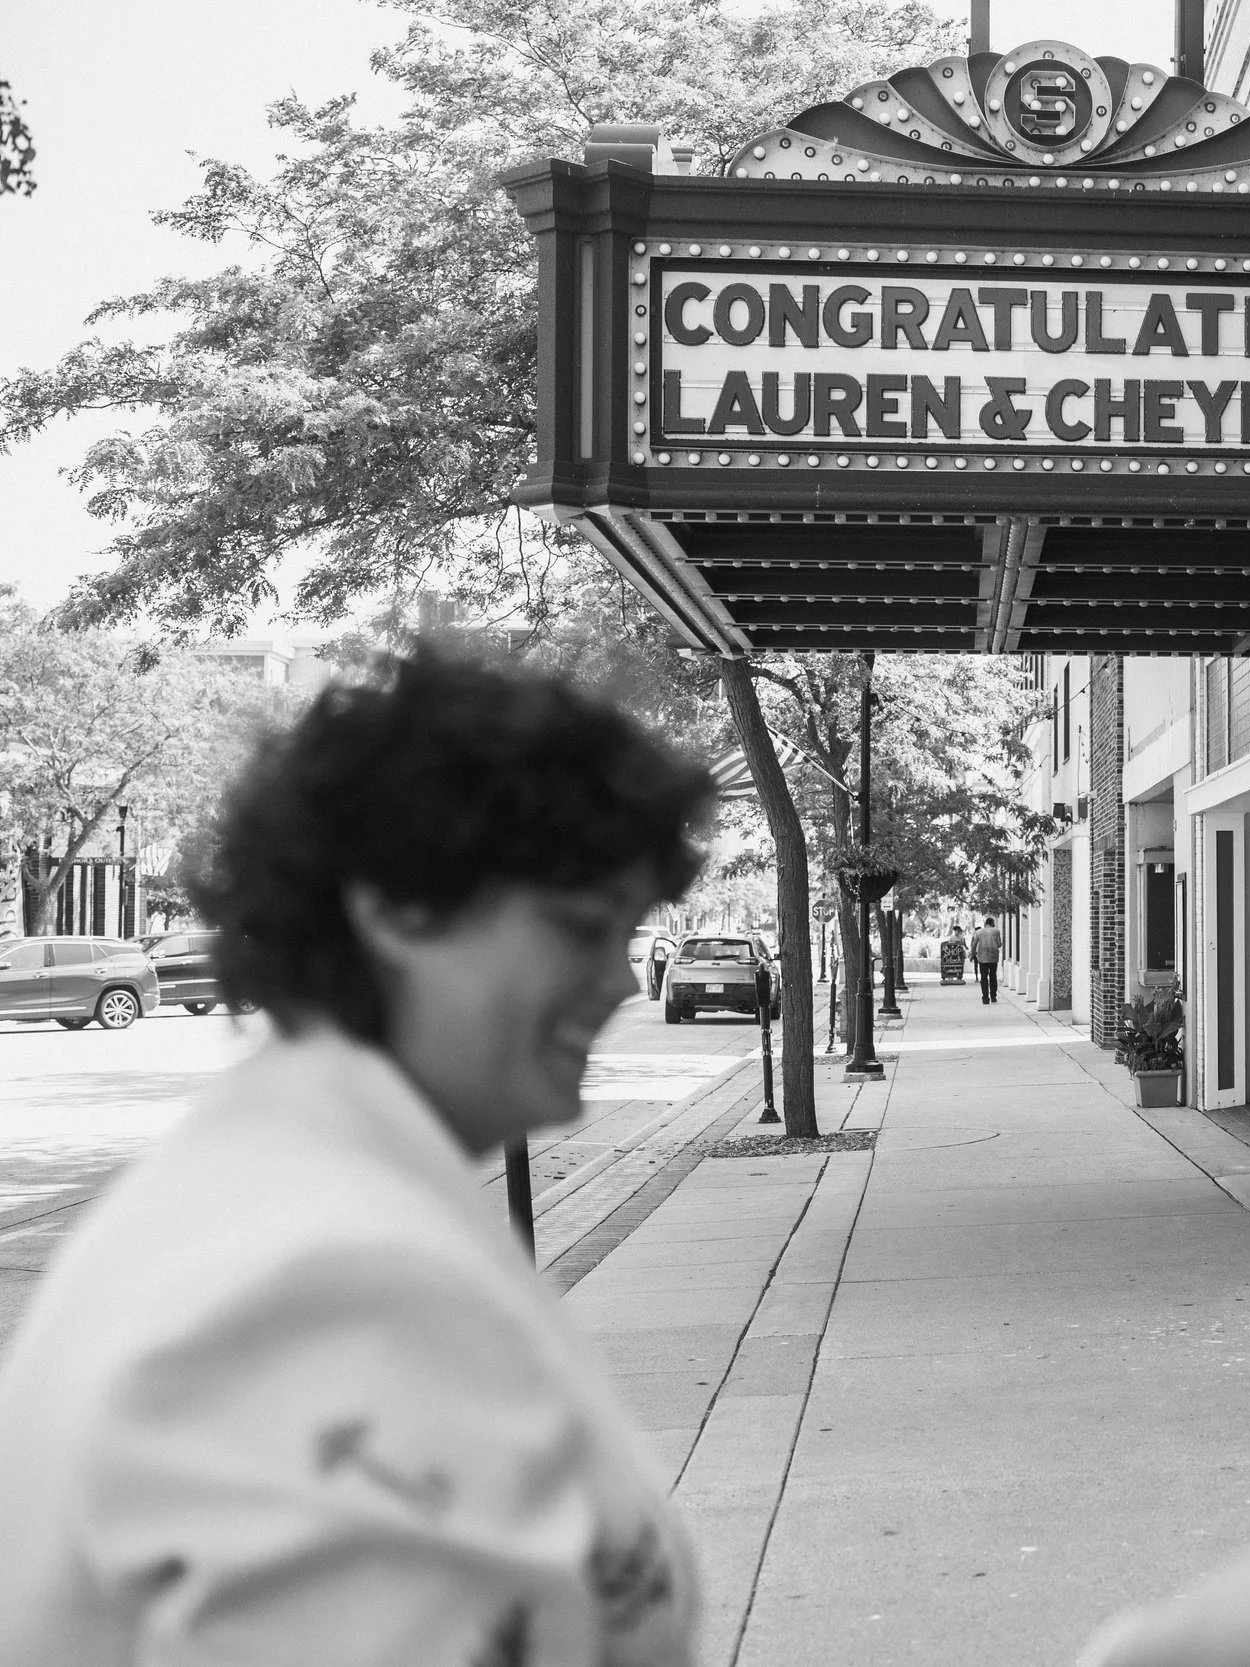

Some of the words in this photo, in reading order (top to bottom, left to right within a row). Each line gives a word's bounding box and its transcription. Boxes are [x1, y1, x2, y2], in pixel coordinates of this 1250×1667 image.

[1021, 71, 1076, 135] S
[663, 370, 961, 439] LAUREN
[979, 376, 1032, 441] &
